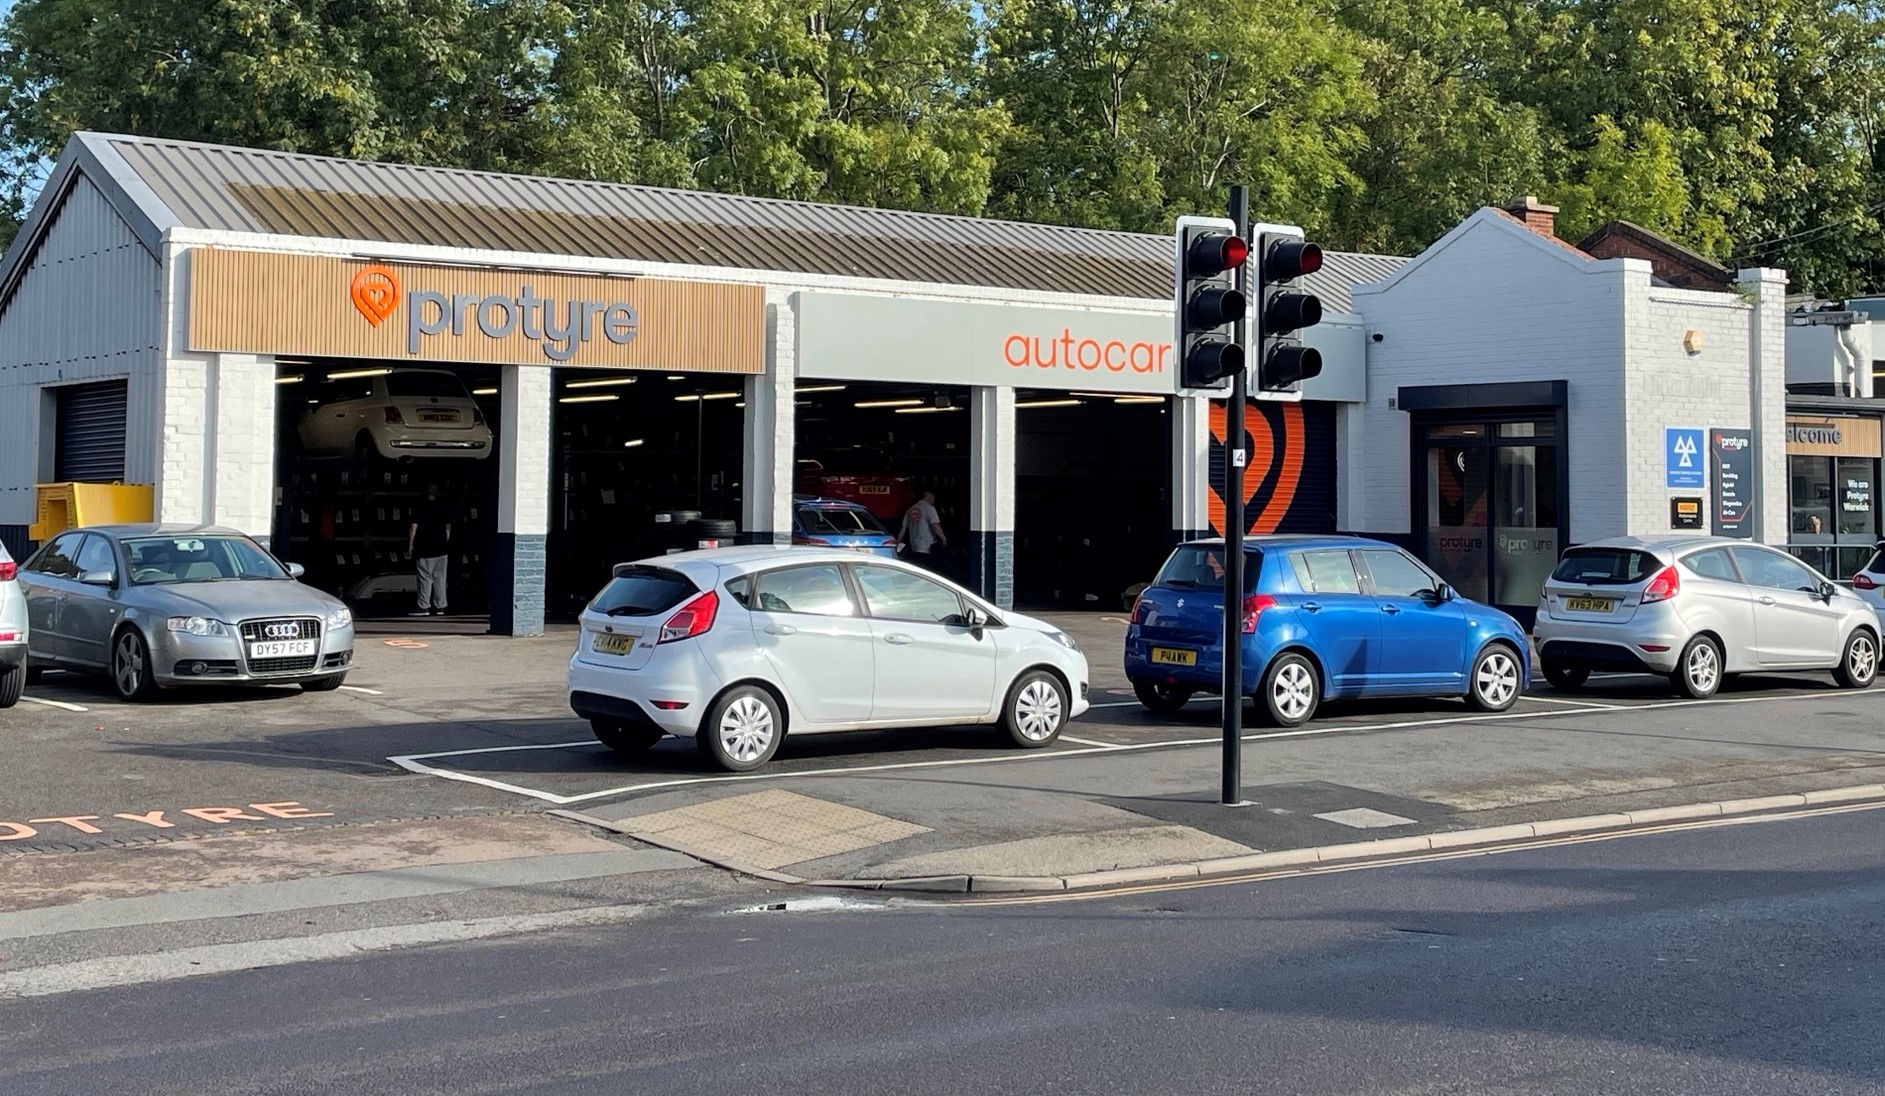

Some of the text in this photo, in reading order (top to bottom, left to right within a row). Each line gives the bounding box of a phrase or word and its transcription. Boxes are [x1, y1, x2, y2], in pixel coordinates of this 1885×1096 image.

[408, 285, 638, 361] protyre
[1004, 328, 1175, 373] autocar
[1786, 422, 1842, 444] elcome
[1721, 437, 1748, 450] protyre
[1236, 452, 1244, 463] 4
[1847, 479, 1858, 488] We
[1846, 490, 1869, 502] Protyre
[1842, 502, 1870, 511] Warwick
[1440, 537, 1482, 552] protyre
[1568, 600, 1609, 611] KV63 HPA
[256, 641, 309, 656] DY57 FCF
